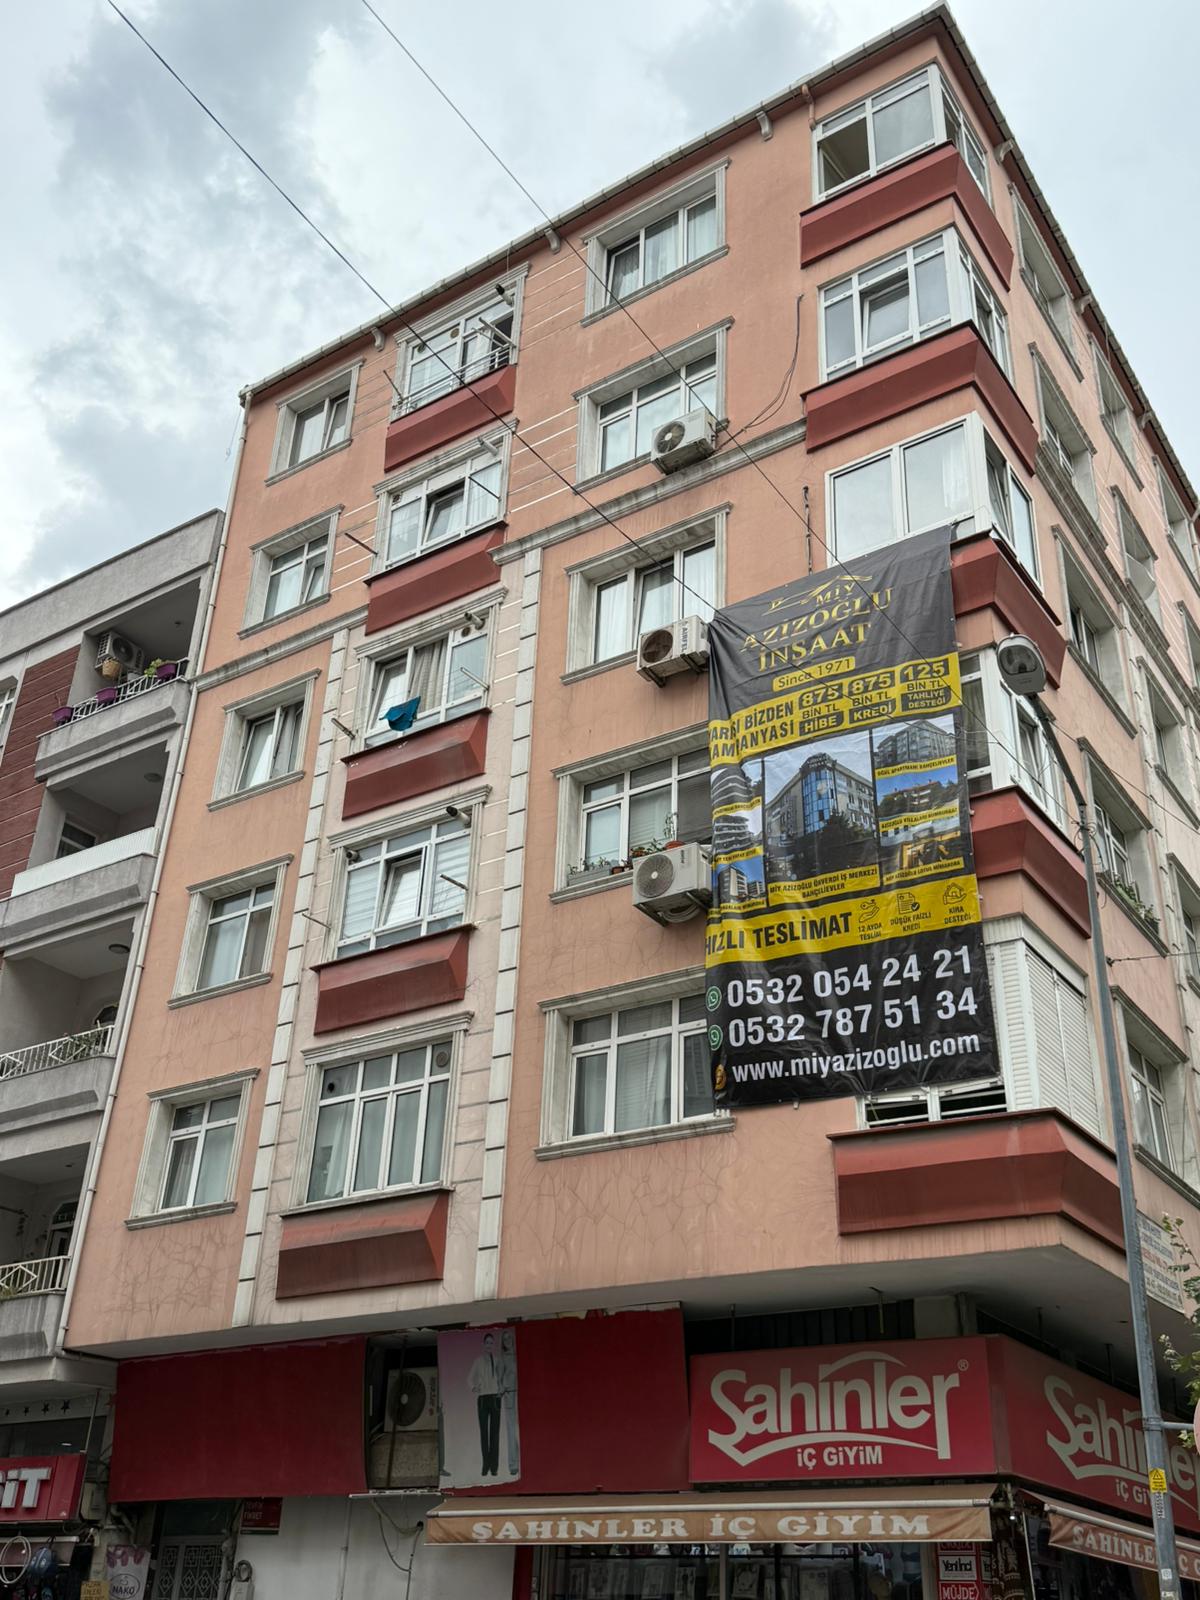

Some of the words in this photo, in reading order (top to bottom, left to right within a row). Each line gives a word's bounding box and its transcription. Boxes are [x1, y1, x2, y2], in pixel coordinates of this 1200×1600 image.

[817, 659, 851, 675] 1971
[904, 662, 945, 681] 125
[851, 674, 891, 694] 875
[906, 680, 927, 692] BİN
[930, 678, 944, 688] TL
[801, 687, 840, 707] 875
[852, 694, 873, 707] BİN
[876, 691, 892, 701] TL
[908, 689, 945, 700] TAHLİYE
[744, 701, 794, 730] BİZDEN
[802, 706, 822, 720] BİN
[825, 702, 841, 712] TL
[853, 703, 893, 720] KREDİ
[804, 714, 837, 733] HİBE
[709, 720, 794, 760] AMANYASI
[705, 930, 745, 955] HIZLI
[753, 912, 852, 949] TESLİMAT
[727, 974, 804, 1007] 0532
[813, 963, 872, 998] 054
[882, 954, 921, 987] 24
[933, 945, 972, 979] 21
[728, 1014, 806, 1048] 0532
[815, 1003, 873, 1039] 787
[884, 994, 921, 1029] 51
[936, 986, 978, 1020] 34
[732, 1033, 981, 1083] www.miyazizoglu.com
[472, 1516, 690, 1543] ŞAHİNLER
[709, 1513, 756, 1540] İÇ
[777, 1510, 931, 1536] GİYİM
[1072, 1525, 1157, 1565] ŞAHİNLE
[112, 1585, 135, 1595] NAKO
[942, 1585, 975, 1600] MÜJDE
